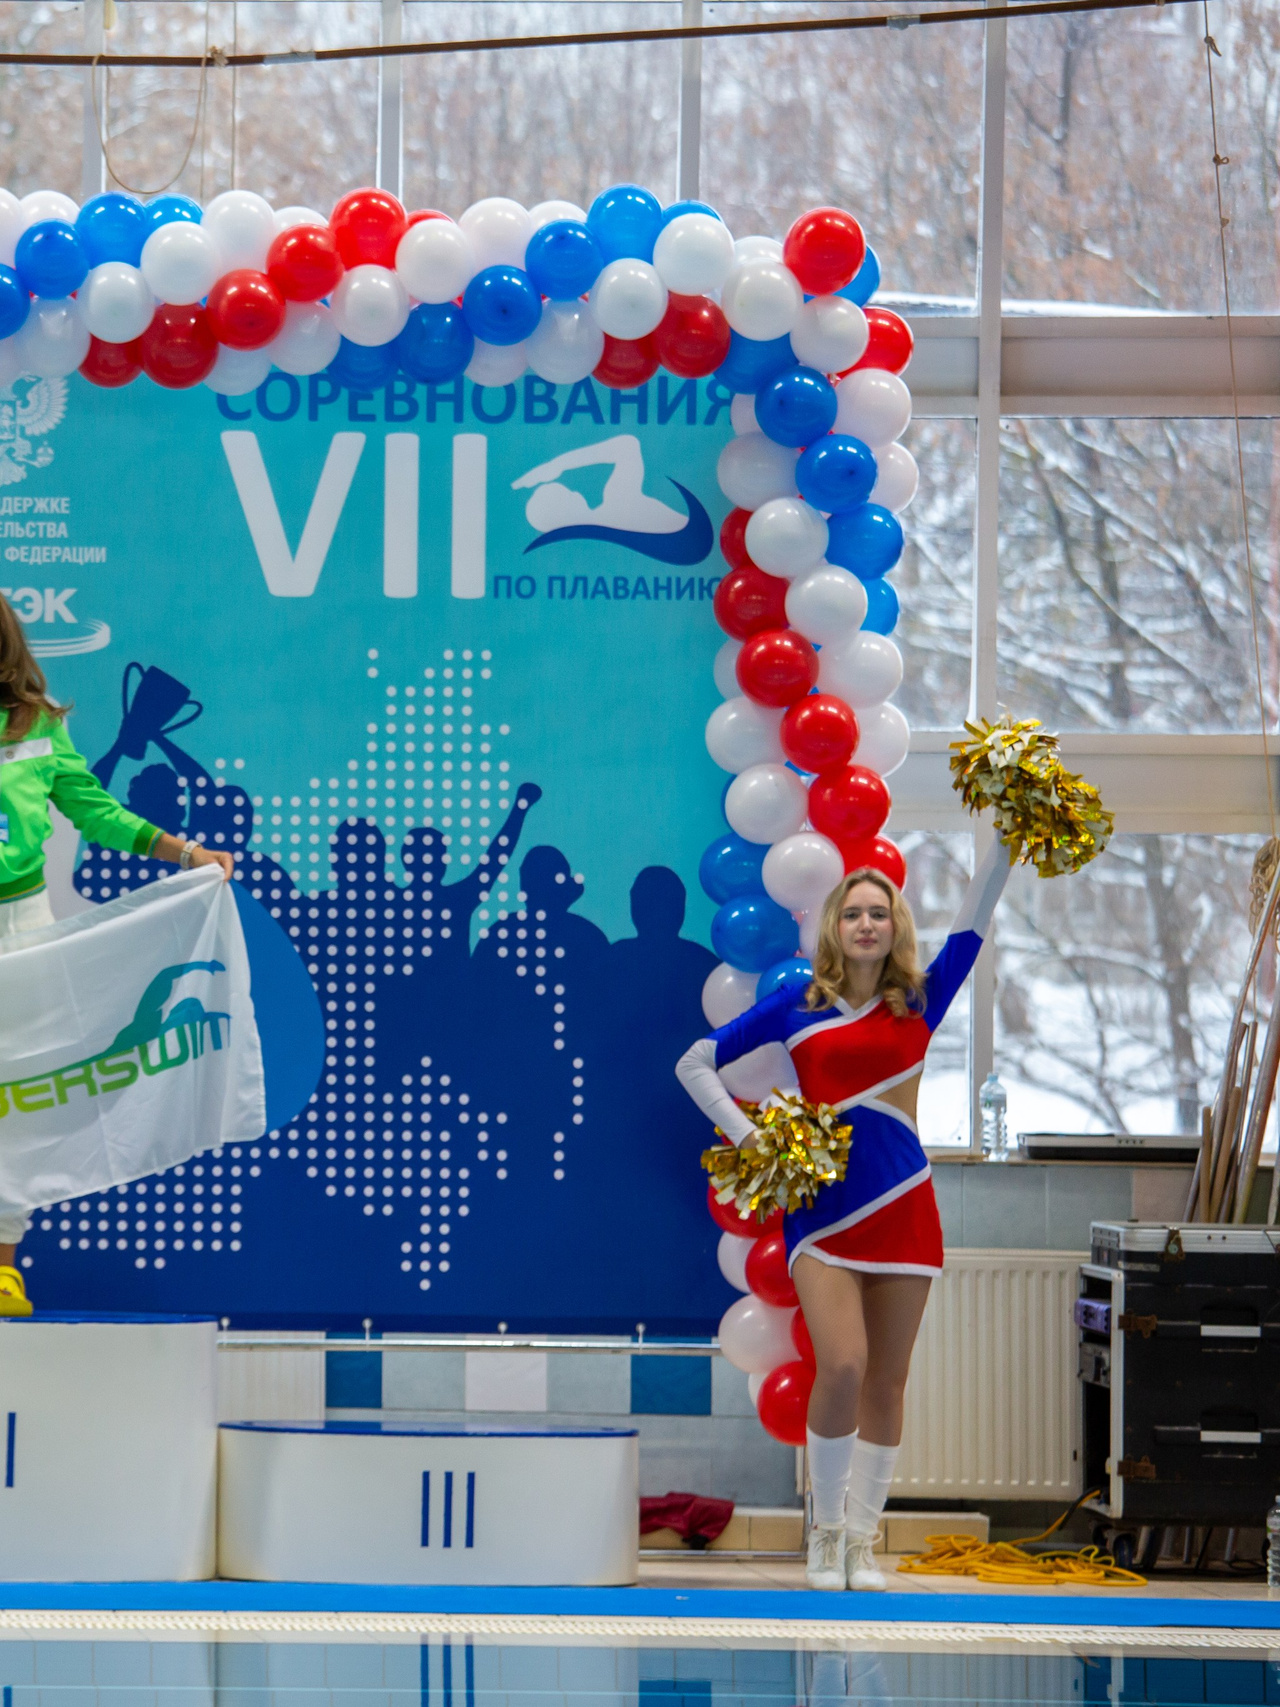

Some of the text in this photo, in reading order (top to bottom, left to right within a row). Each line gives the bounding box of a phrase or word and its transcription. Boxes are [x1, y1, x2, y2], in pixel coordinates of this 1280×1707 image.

[221, 430, 487, 600] VII
[5, 545, 107, 565] ФЕДЕРАЦИИ
[494, 575, 537, 600] ПО
[5, 1412, 17, 1489] I
[420, 1470, 476, 1549] III
